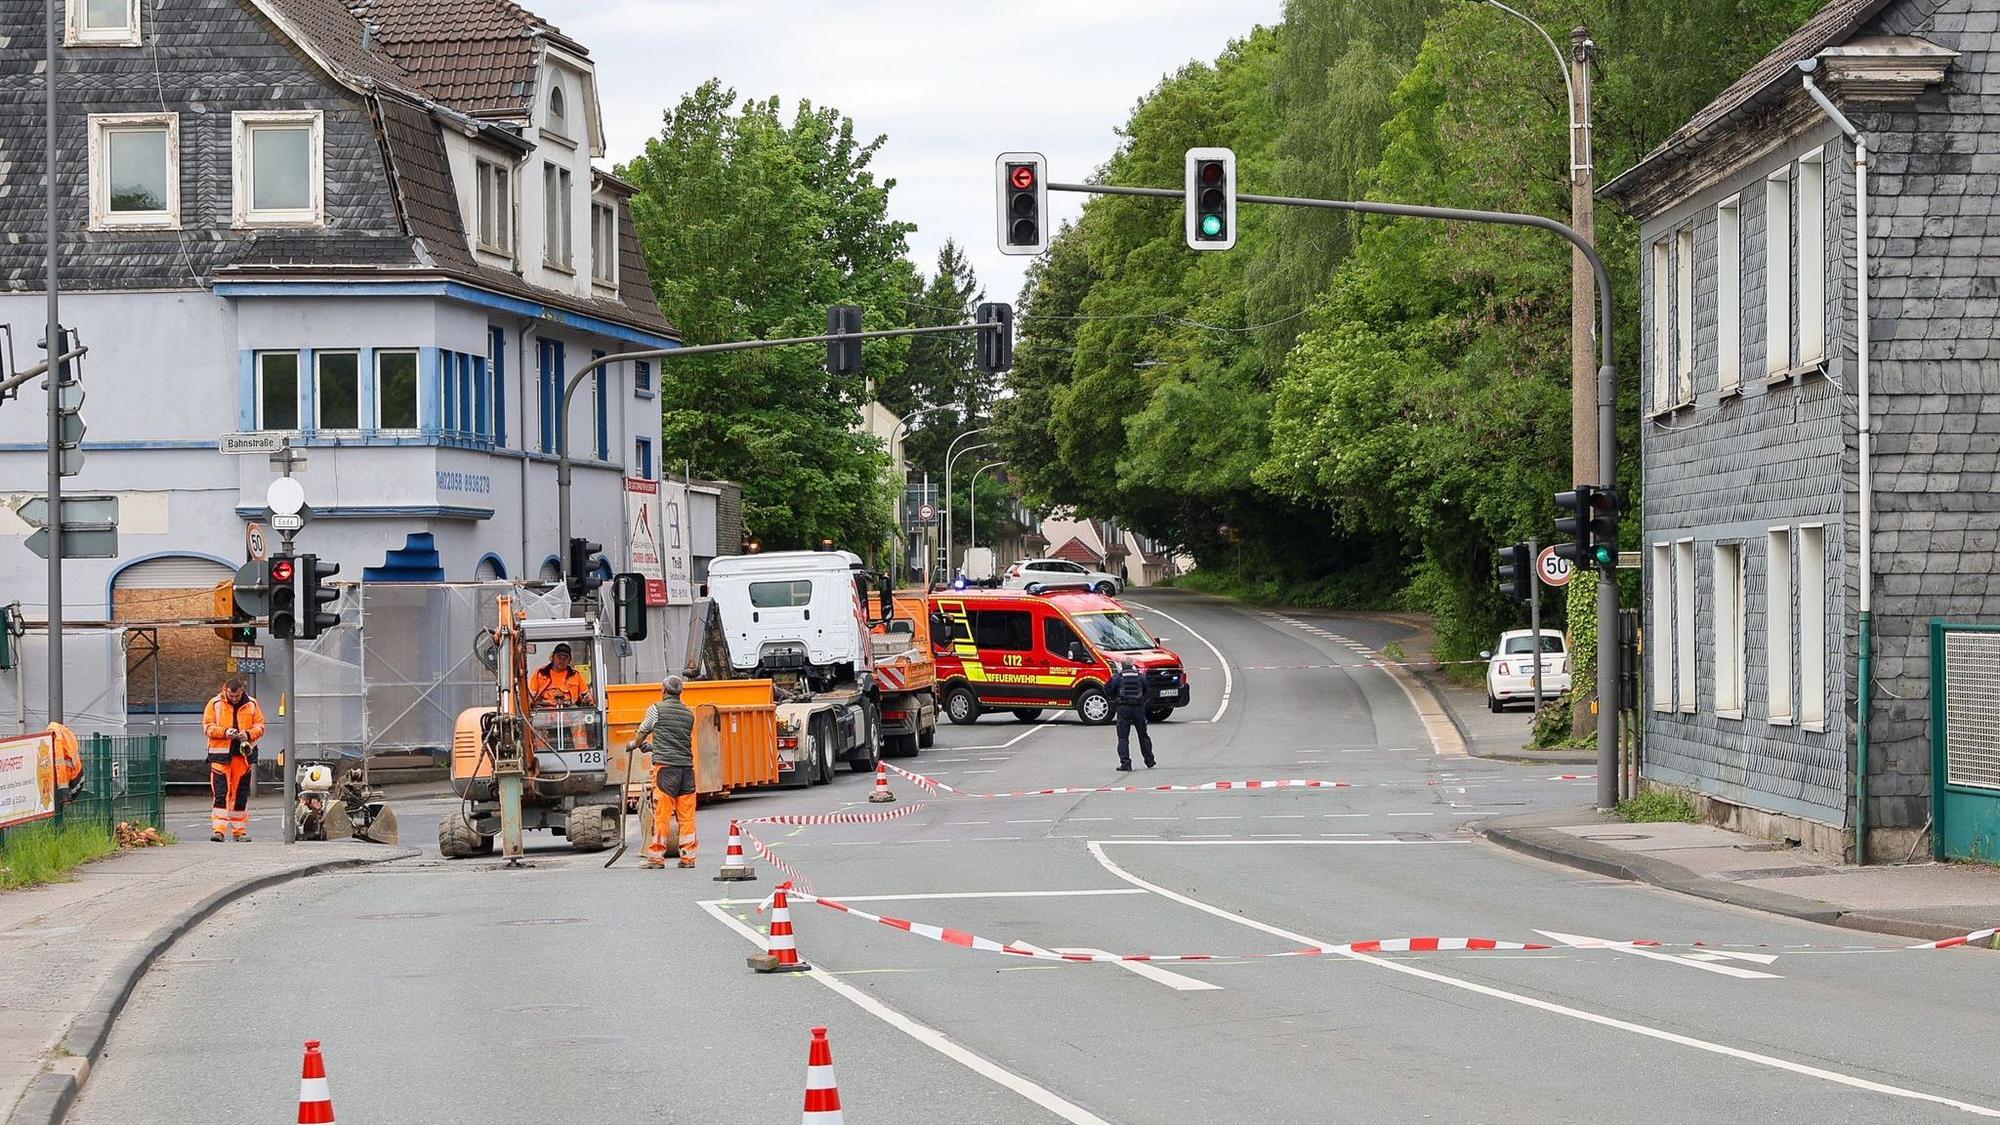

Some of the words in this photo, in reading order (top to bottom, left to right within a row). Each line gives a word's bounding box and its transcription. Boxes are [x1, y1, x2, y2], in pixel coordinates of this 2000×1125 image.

[228, 438, 274, 448] Bahnstraße
[251, 534, 263, 551] 50
[1546, 557, 1568, 574] 50
[1007, 654, 1022, 666] 112
[991, 674, 1036, 684] FEUERWEHR
[578, 752, 601, 763] 128
